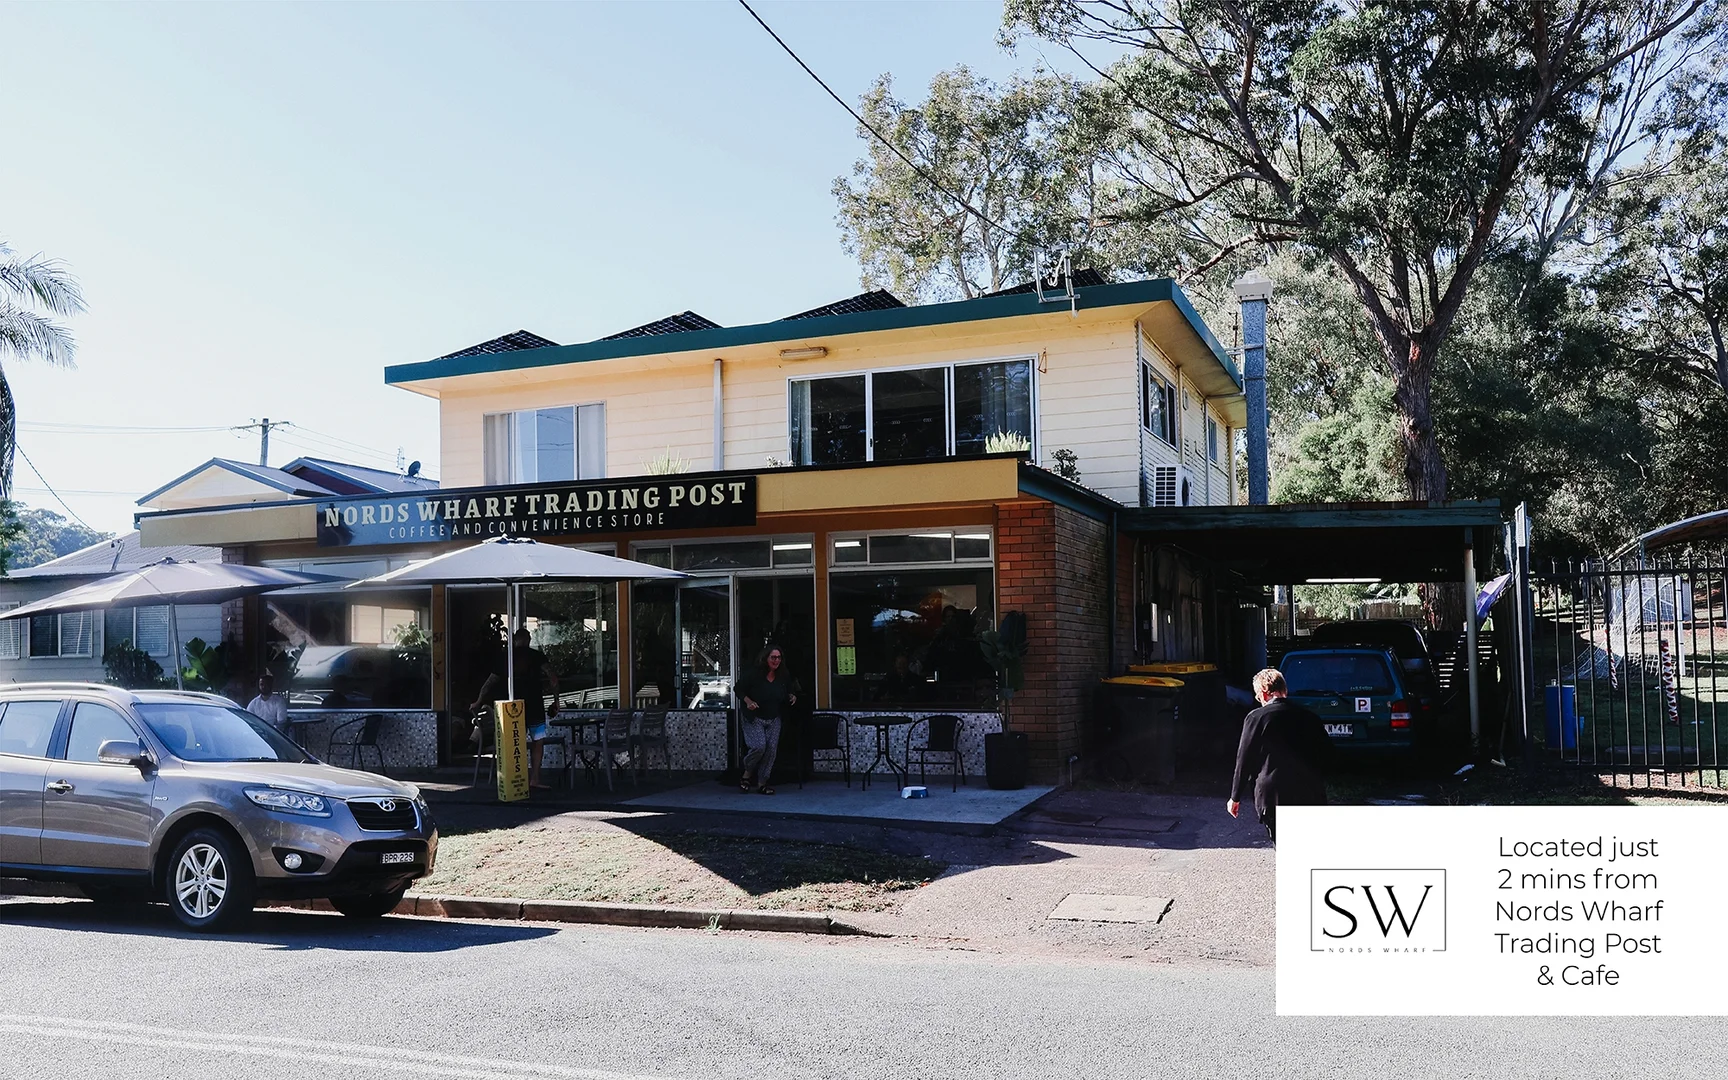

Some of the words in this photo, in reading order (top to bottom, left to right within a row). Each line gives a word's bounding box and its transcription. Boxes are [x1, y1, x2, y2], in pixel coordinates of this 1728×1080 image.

[325, 502, 410, 528] NORDS
[416, 495, 518, 522] WHARF
[525, 487, 661, 515] TRADING
[668, 482, 746, 507] POST
[389, 524, 445, 539] COFFEE
[452, 522, 482, 535] AND
[488, 515, 603, 533] CONVENIENCE
[610, 512, 664, 527] STORE
[1358, 699, 1367, 711] P
[511, 721, 521, 773] TREATS
